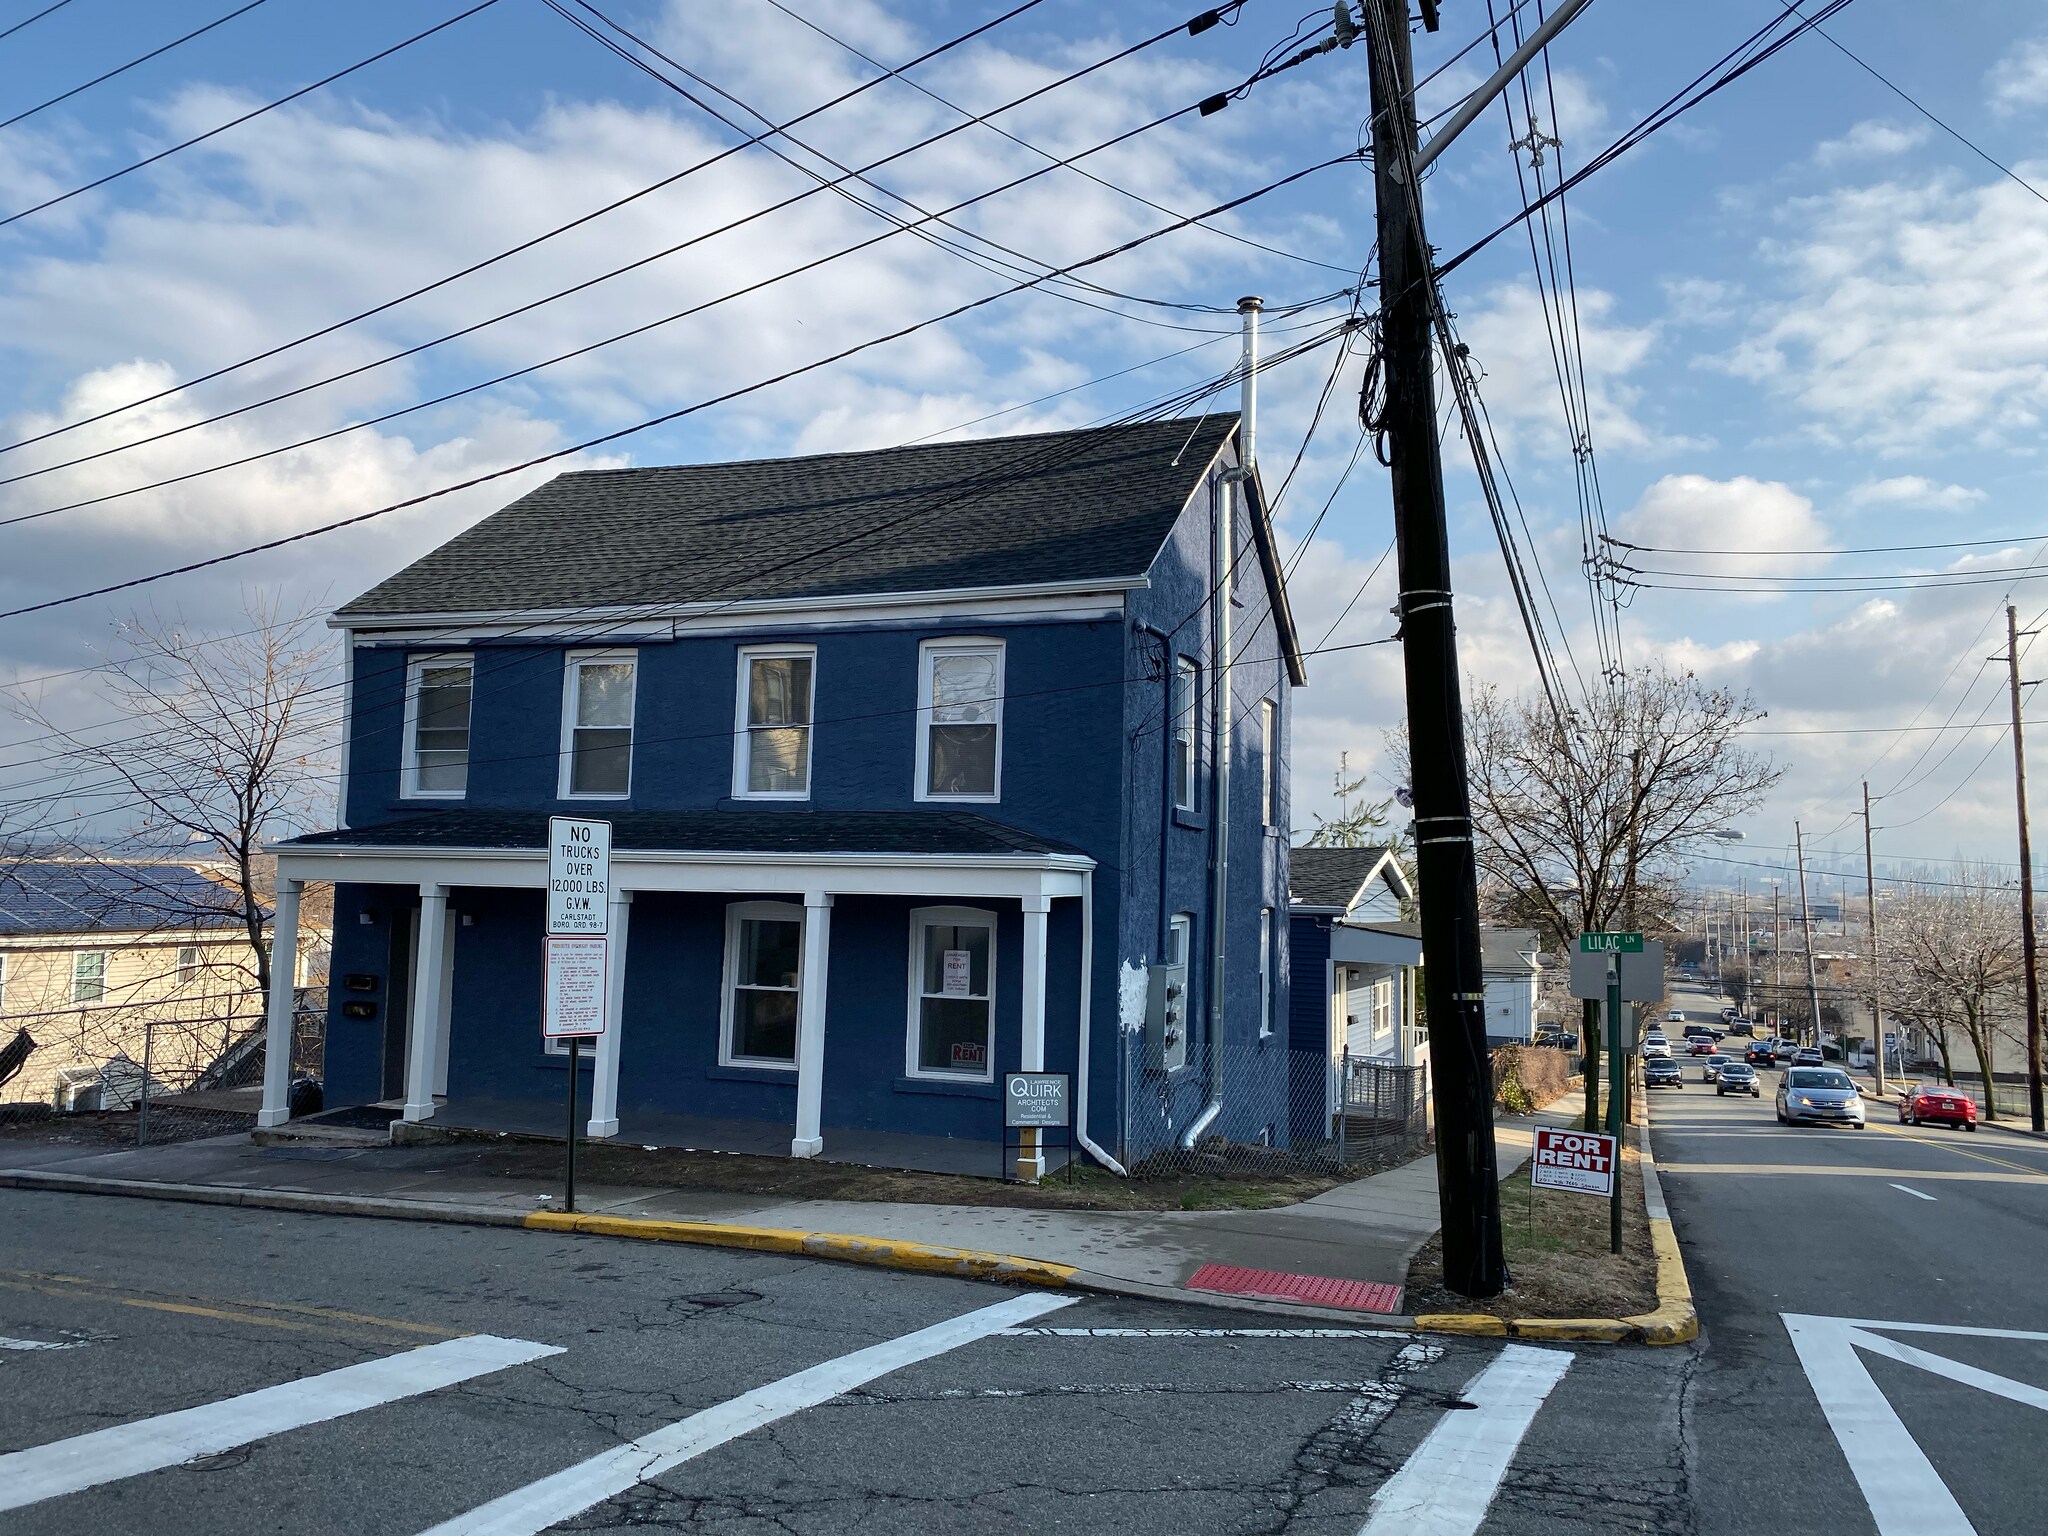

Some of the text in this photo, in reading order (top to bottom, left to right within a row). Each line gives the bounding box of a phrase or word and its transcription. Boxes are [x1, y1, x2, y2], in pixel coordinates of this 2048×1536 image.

[570, 826, 591, 842] NO
[561, 845, 600, 860] TRUCKS
[566, 862, 593, 876] OVER
[586, 880, 606, 894] LBS.
[566, 897, 591, 910] G.V.W.
[560, 913, 596, 921] CARLSTADT
[589, 921, 603, 929] 98-7
[1587, 935, 1635, 950] LILAC LN
[952, 1044, 985, 1062] RENT
[1010, 1077, 1062, 1097] QUIRK
[1548, 1134, 1601, 1155] FOR
[1539, 1149, 1609, 1171] RENT
